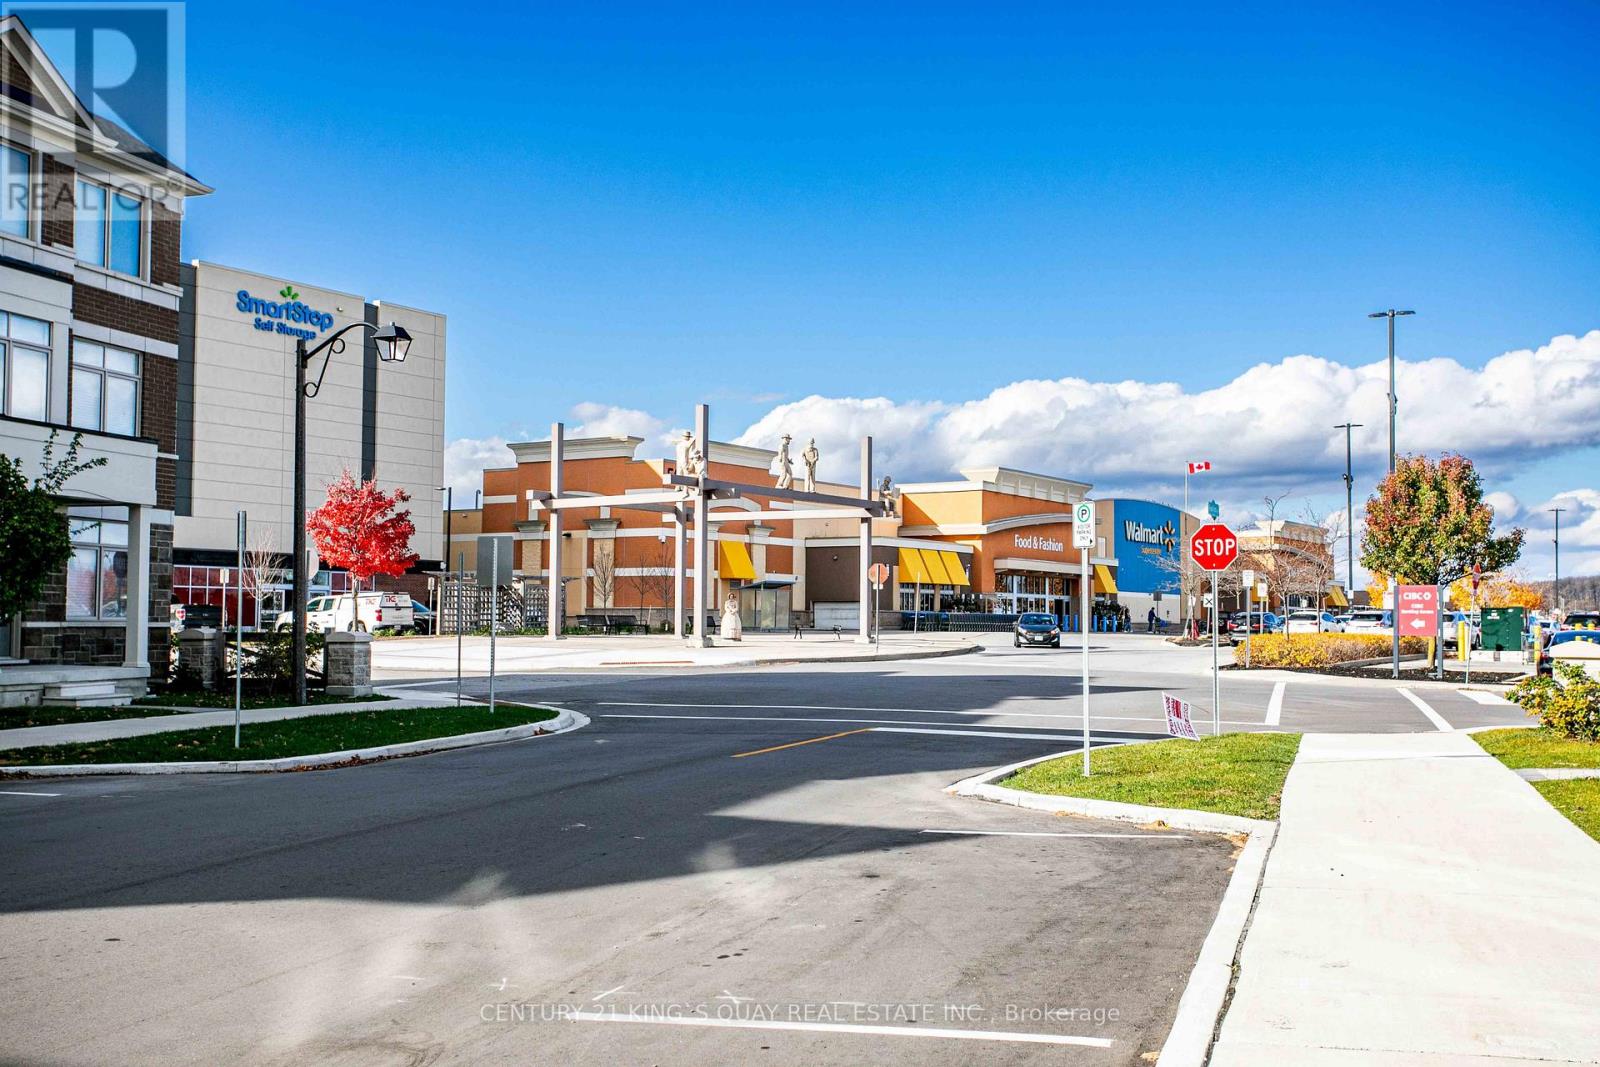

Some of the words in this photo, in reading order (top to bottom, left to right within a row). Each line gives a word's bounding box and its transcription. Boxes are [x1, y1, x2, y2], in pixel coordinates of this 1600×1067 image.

[236, 289, 333, 332] SmartStop
[254, 317, 274, 332] Self
[276, 322, 316, 341] Storage
[1081, 509, 1088, 519] P
[1125, 520, 1164, 545] Walmart
[1014, 534, 1032, 549] Food
[1033, 536, 1039, 550] &
[1040, 537, 1064, 553] Fashion
[1194, 538, 1236, 557] STOP
